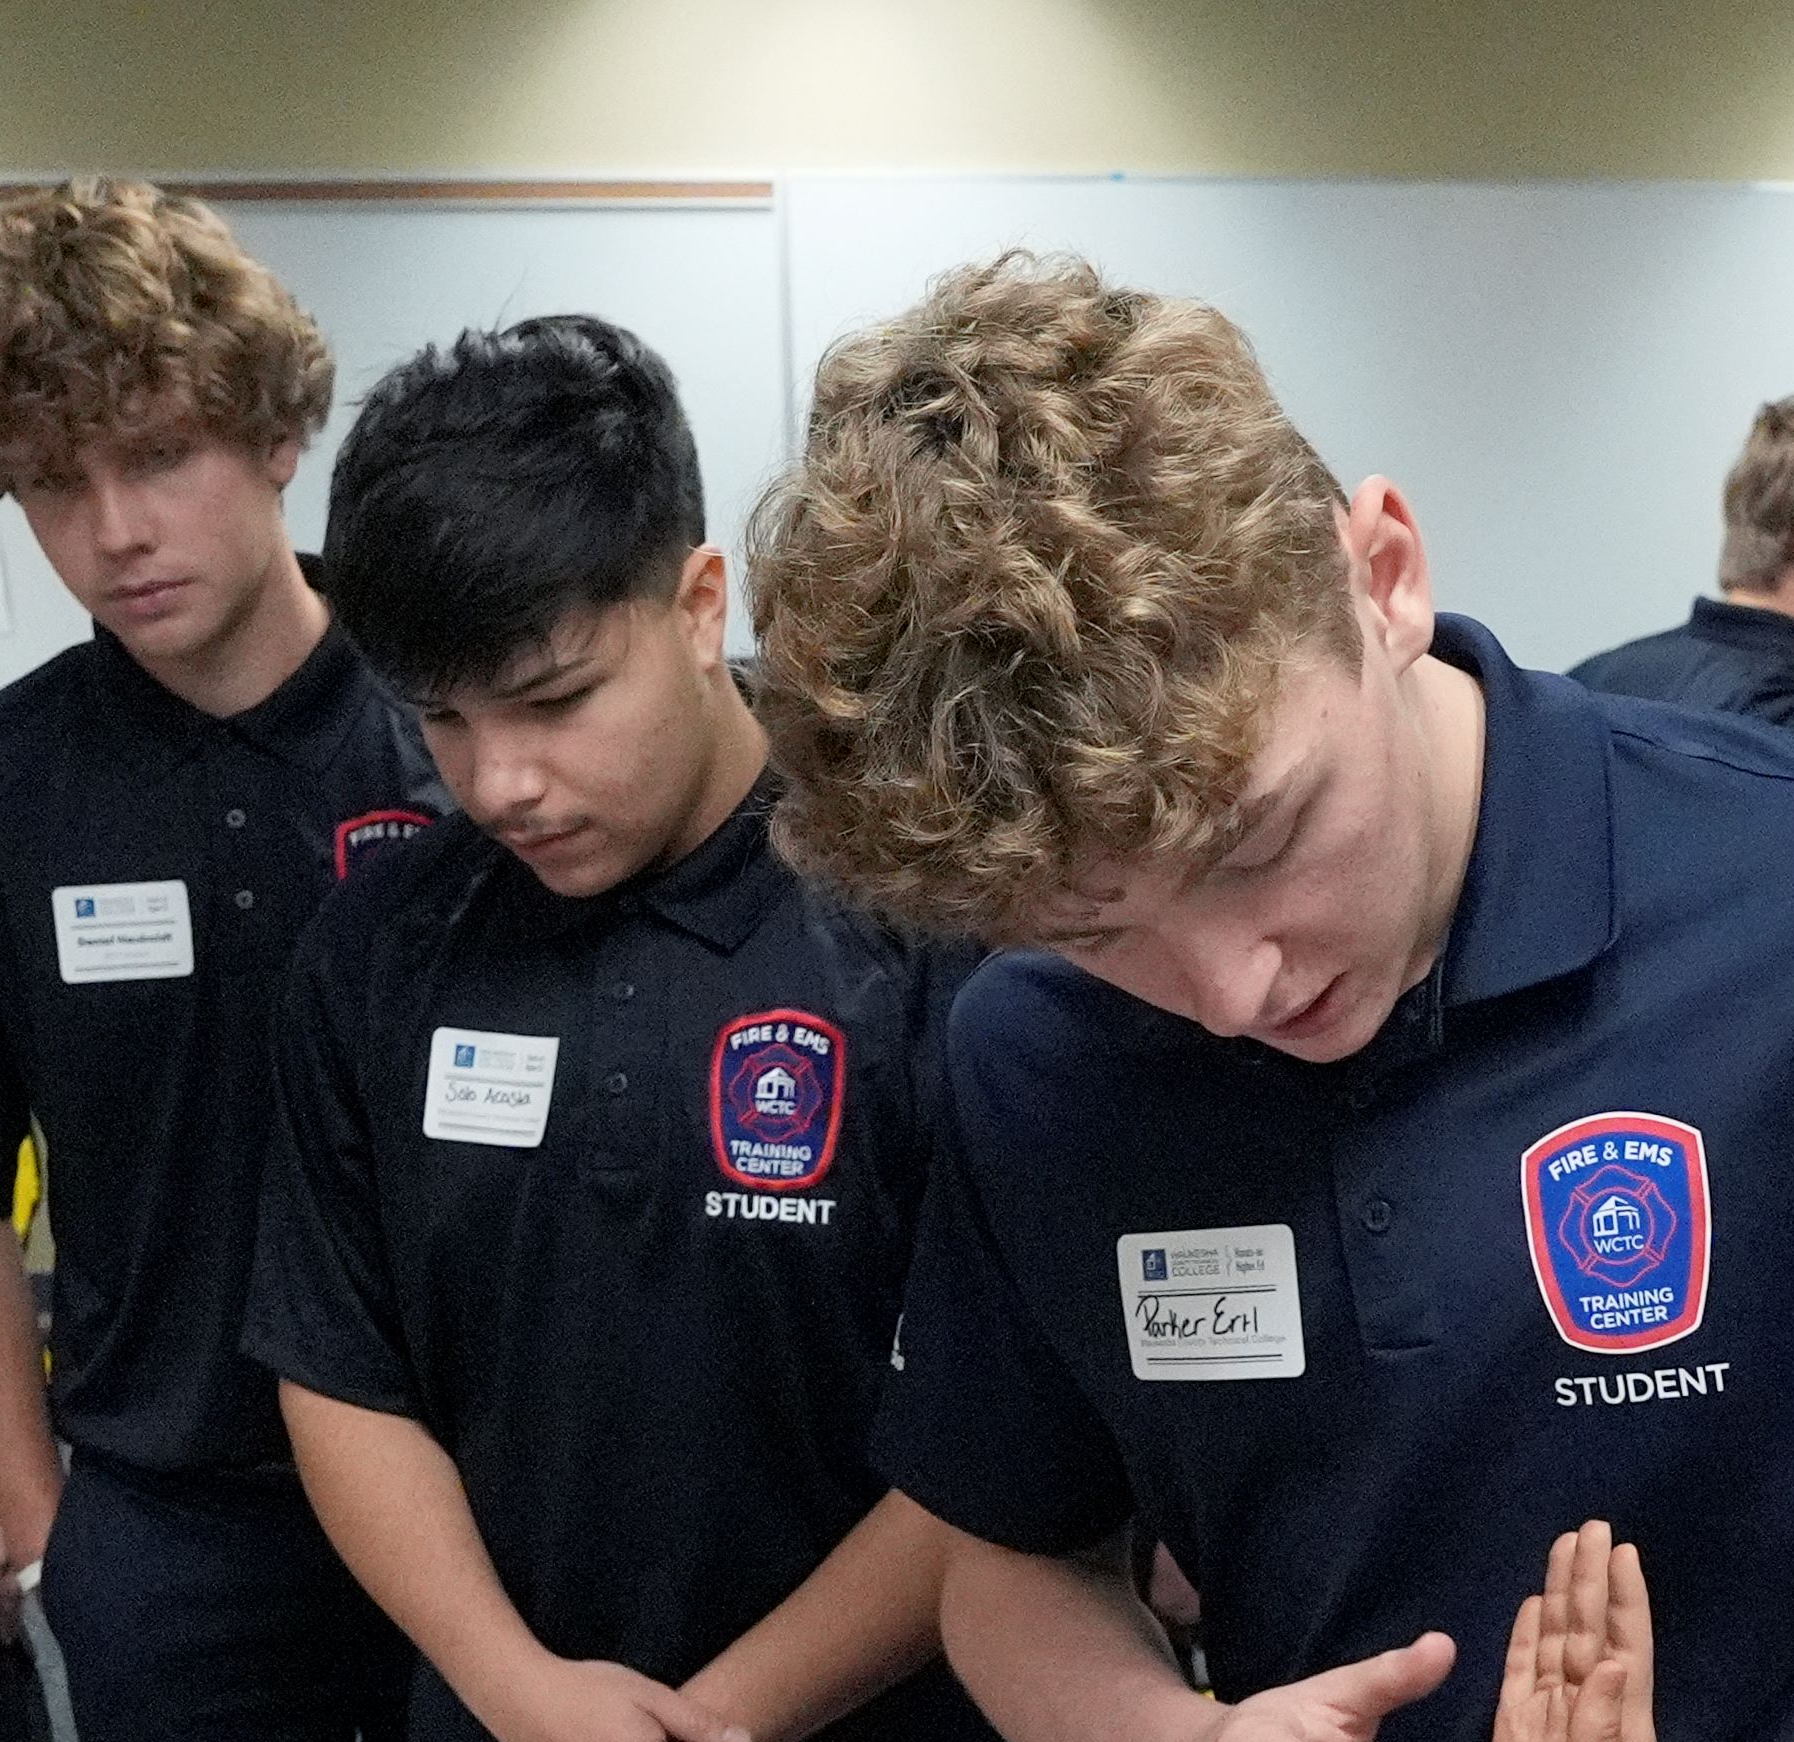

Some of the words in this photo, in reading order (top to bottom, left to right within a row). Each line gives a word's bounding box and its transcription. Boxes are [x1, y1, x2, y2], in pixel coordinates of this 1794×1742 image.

[729, 1025, 773, 1051] FIRE
[775, 1023, 790, 1042] &
[793, 1026, 831, 1055] EMS
[755, 1100, 796, 1115] WCTC
[730, 1139, 812, 1161] TRAINING
[1548, 1144, 1599, 1181] FIRE
[1602, 1141, 1619, 1161] &
[1624, 1141, 1673, 1167] EMS
[735, 1157, 804, 1175] CENTER
[705, 1191, 836, 1225] STUDENT
[1593, 1234, 1645, 1254] WCTC
[1172, 1264, 1221, 1276] COLLEGE
[1579, 1287, 1674, 1313] TRAINING
[1135, 1295, 1207, 1338] Parker
[1590, 1308, 1669, 1330] CENTER
[1554, 1363, 1730, 1407] STUDENT
